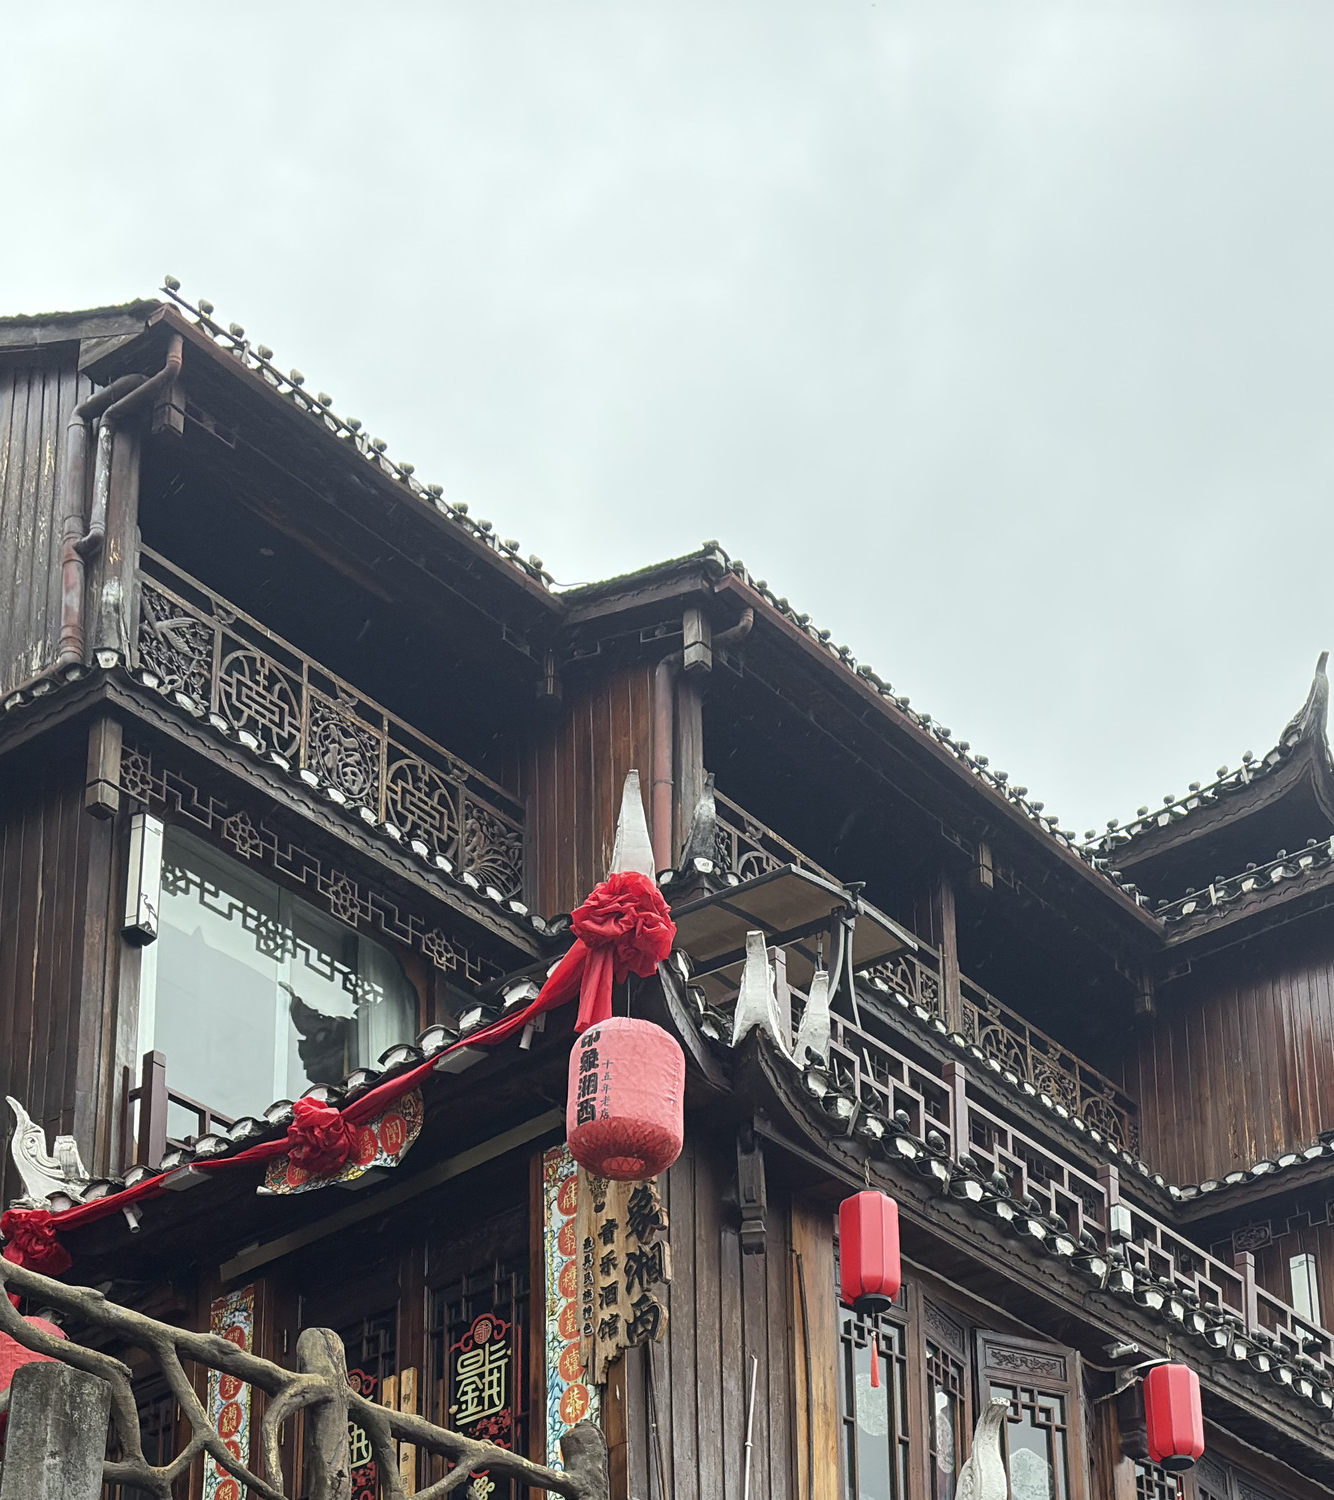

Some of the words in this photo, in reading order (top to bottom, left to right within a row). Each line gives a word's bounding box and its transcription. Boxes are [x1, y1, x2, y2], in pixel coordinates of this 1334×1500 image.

[598, 1218, 620, 1341] 音乐酒馆
[624, 1181, 670, 1345] 象湘西
